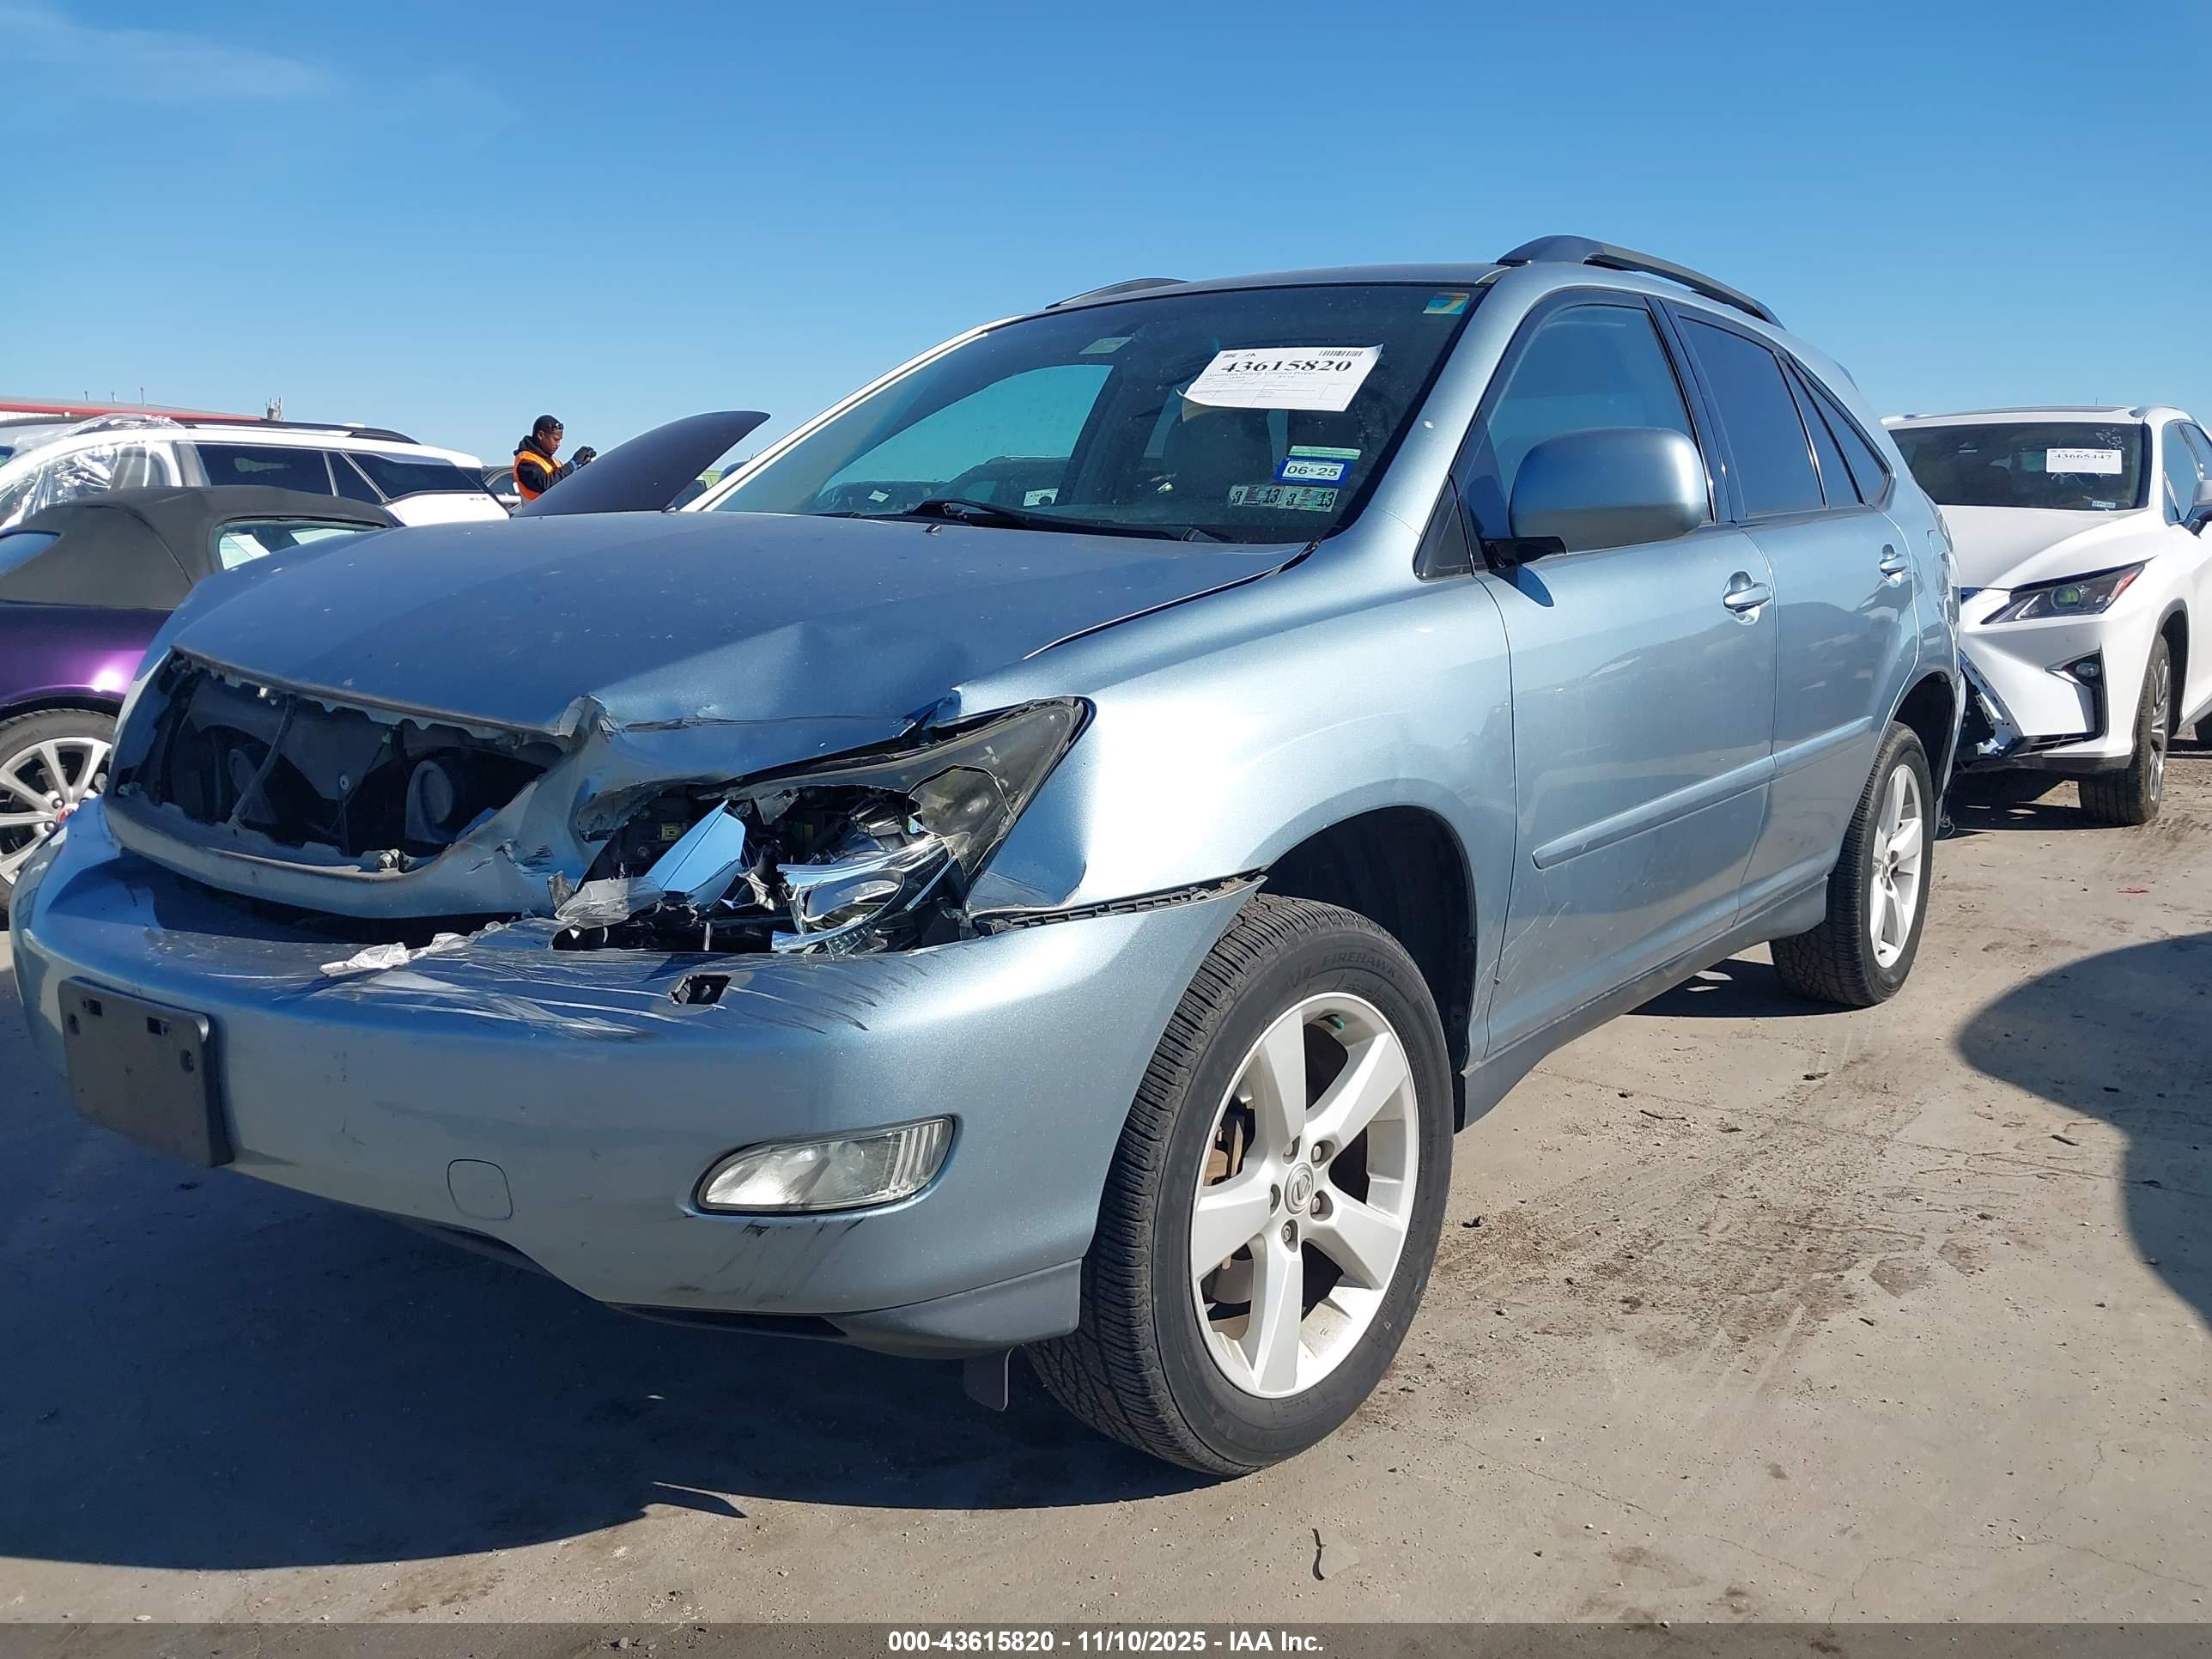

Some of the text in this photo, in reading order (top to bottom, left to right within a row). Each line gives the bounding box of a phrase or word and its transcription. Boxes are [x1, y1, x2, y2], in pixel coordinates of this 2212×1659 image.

[1221, 360, 1352, 373] 43615820
[1262, 488, 1280, 504] 13
[1317, 491, 1335, 507] 13
[1322, 951, 1396, 977] FIREHAWK
